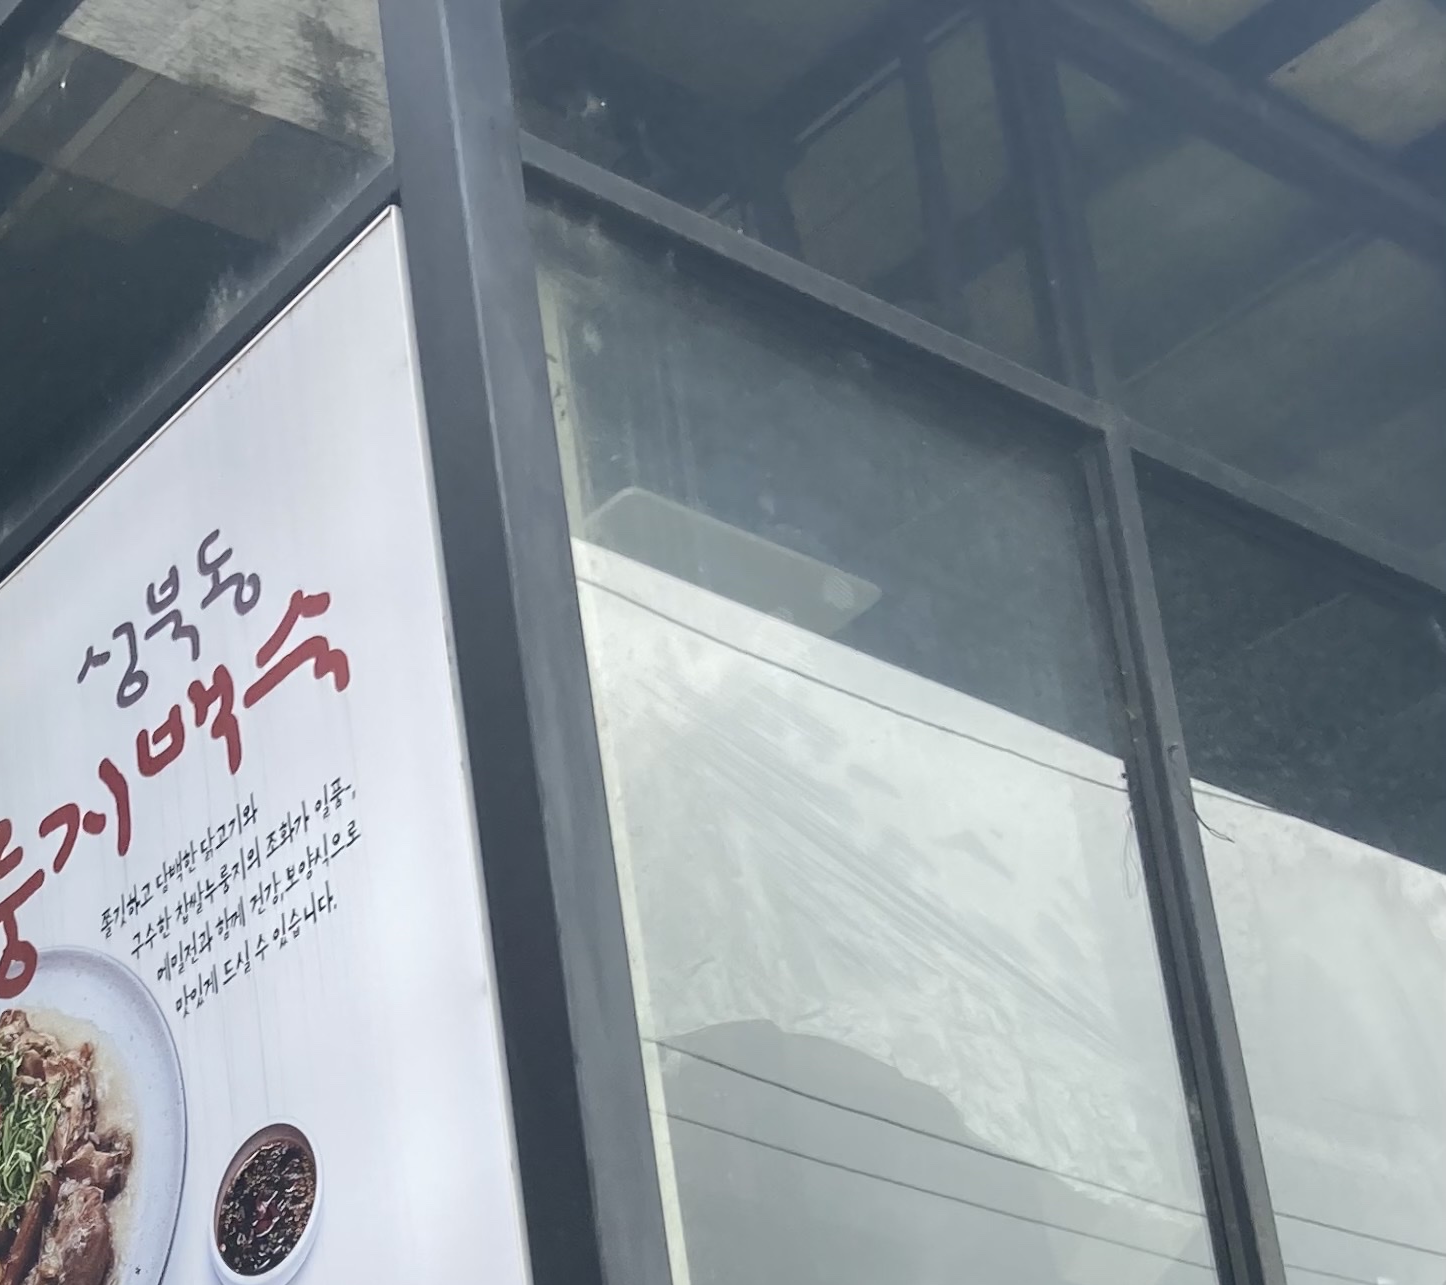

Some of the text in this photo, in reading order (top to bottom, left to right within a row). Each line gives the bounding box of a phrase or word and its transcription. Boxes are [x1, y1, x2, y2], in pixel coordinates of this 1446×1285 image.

[77, 528, 260, 709] 성북동
[100, 792, 258, 939] 쫄깃하고 담백한 닭고기와
[131, 906, 171, 959] 구수한
[175, 836, 262, 925] 찹쌀누룽지의
[266, 800, 310, 859] 조화가
[157, 920, 213, 981] 메밀전과
[214, 896, 246, 940] 함께
[175, 963, 219, 1018] 맛있게
[223, 939, 251, 986] 드실
[254, 933, 269, 960] 수
